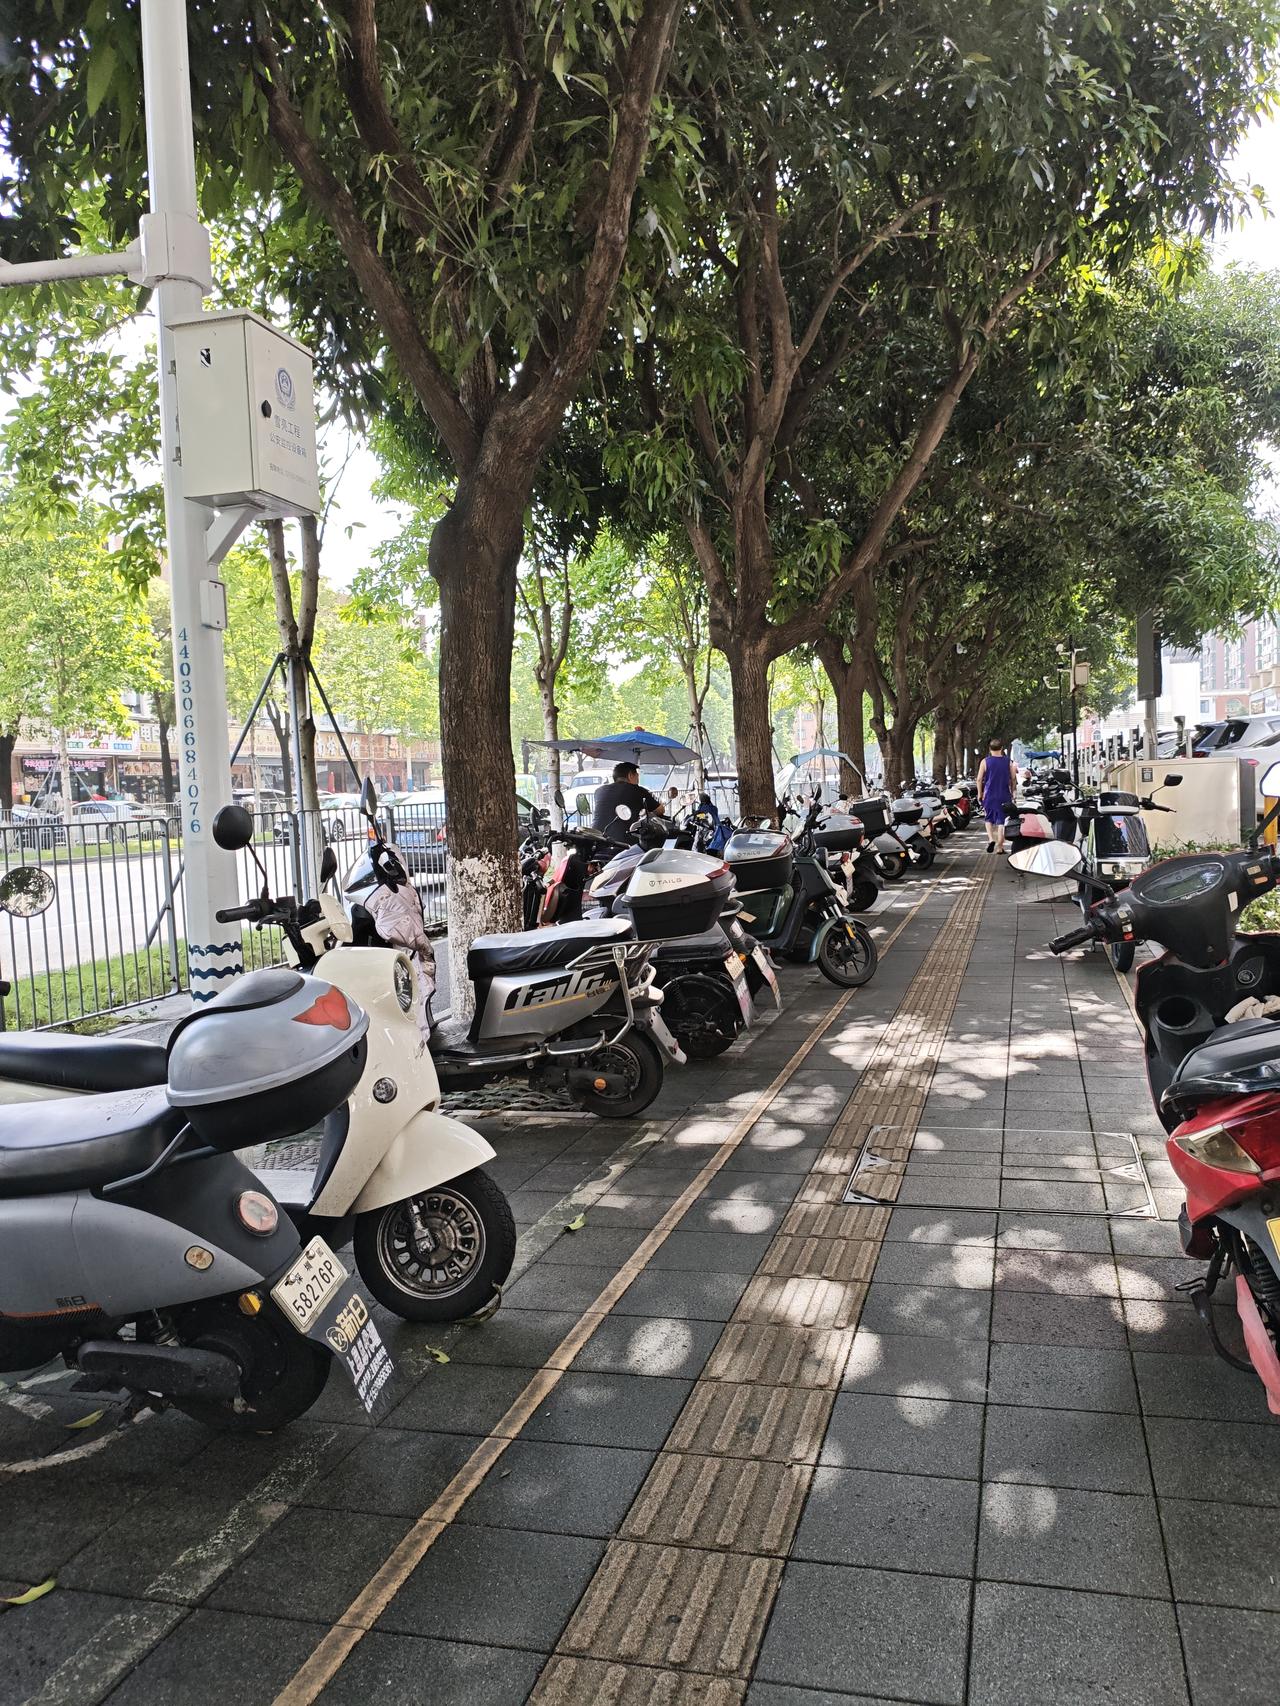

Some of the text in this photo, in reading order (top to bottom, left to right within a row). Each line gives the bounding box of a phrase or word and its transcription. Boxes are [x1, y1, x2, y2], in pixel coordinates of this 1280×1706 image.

[178, 627, 201, 833] 440306684076
[657, 878, 682, 886] TAILG
[292, 1260, 335, 1317] 58276P
[335, 1293, 368, 1344] 新日
